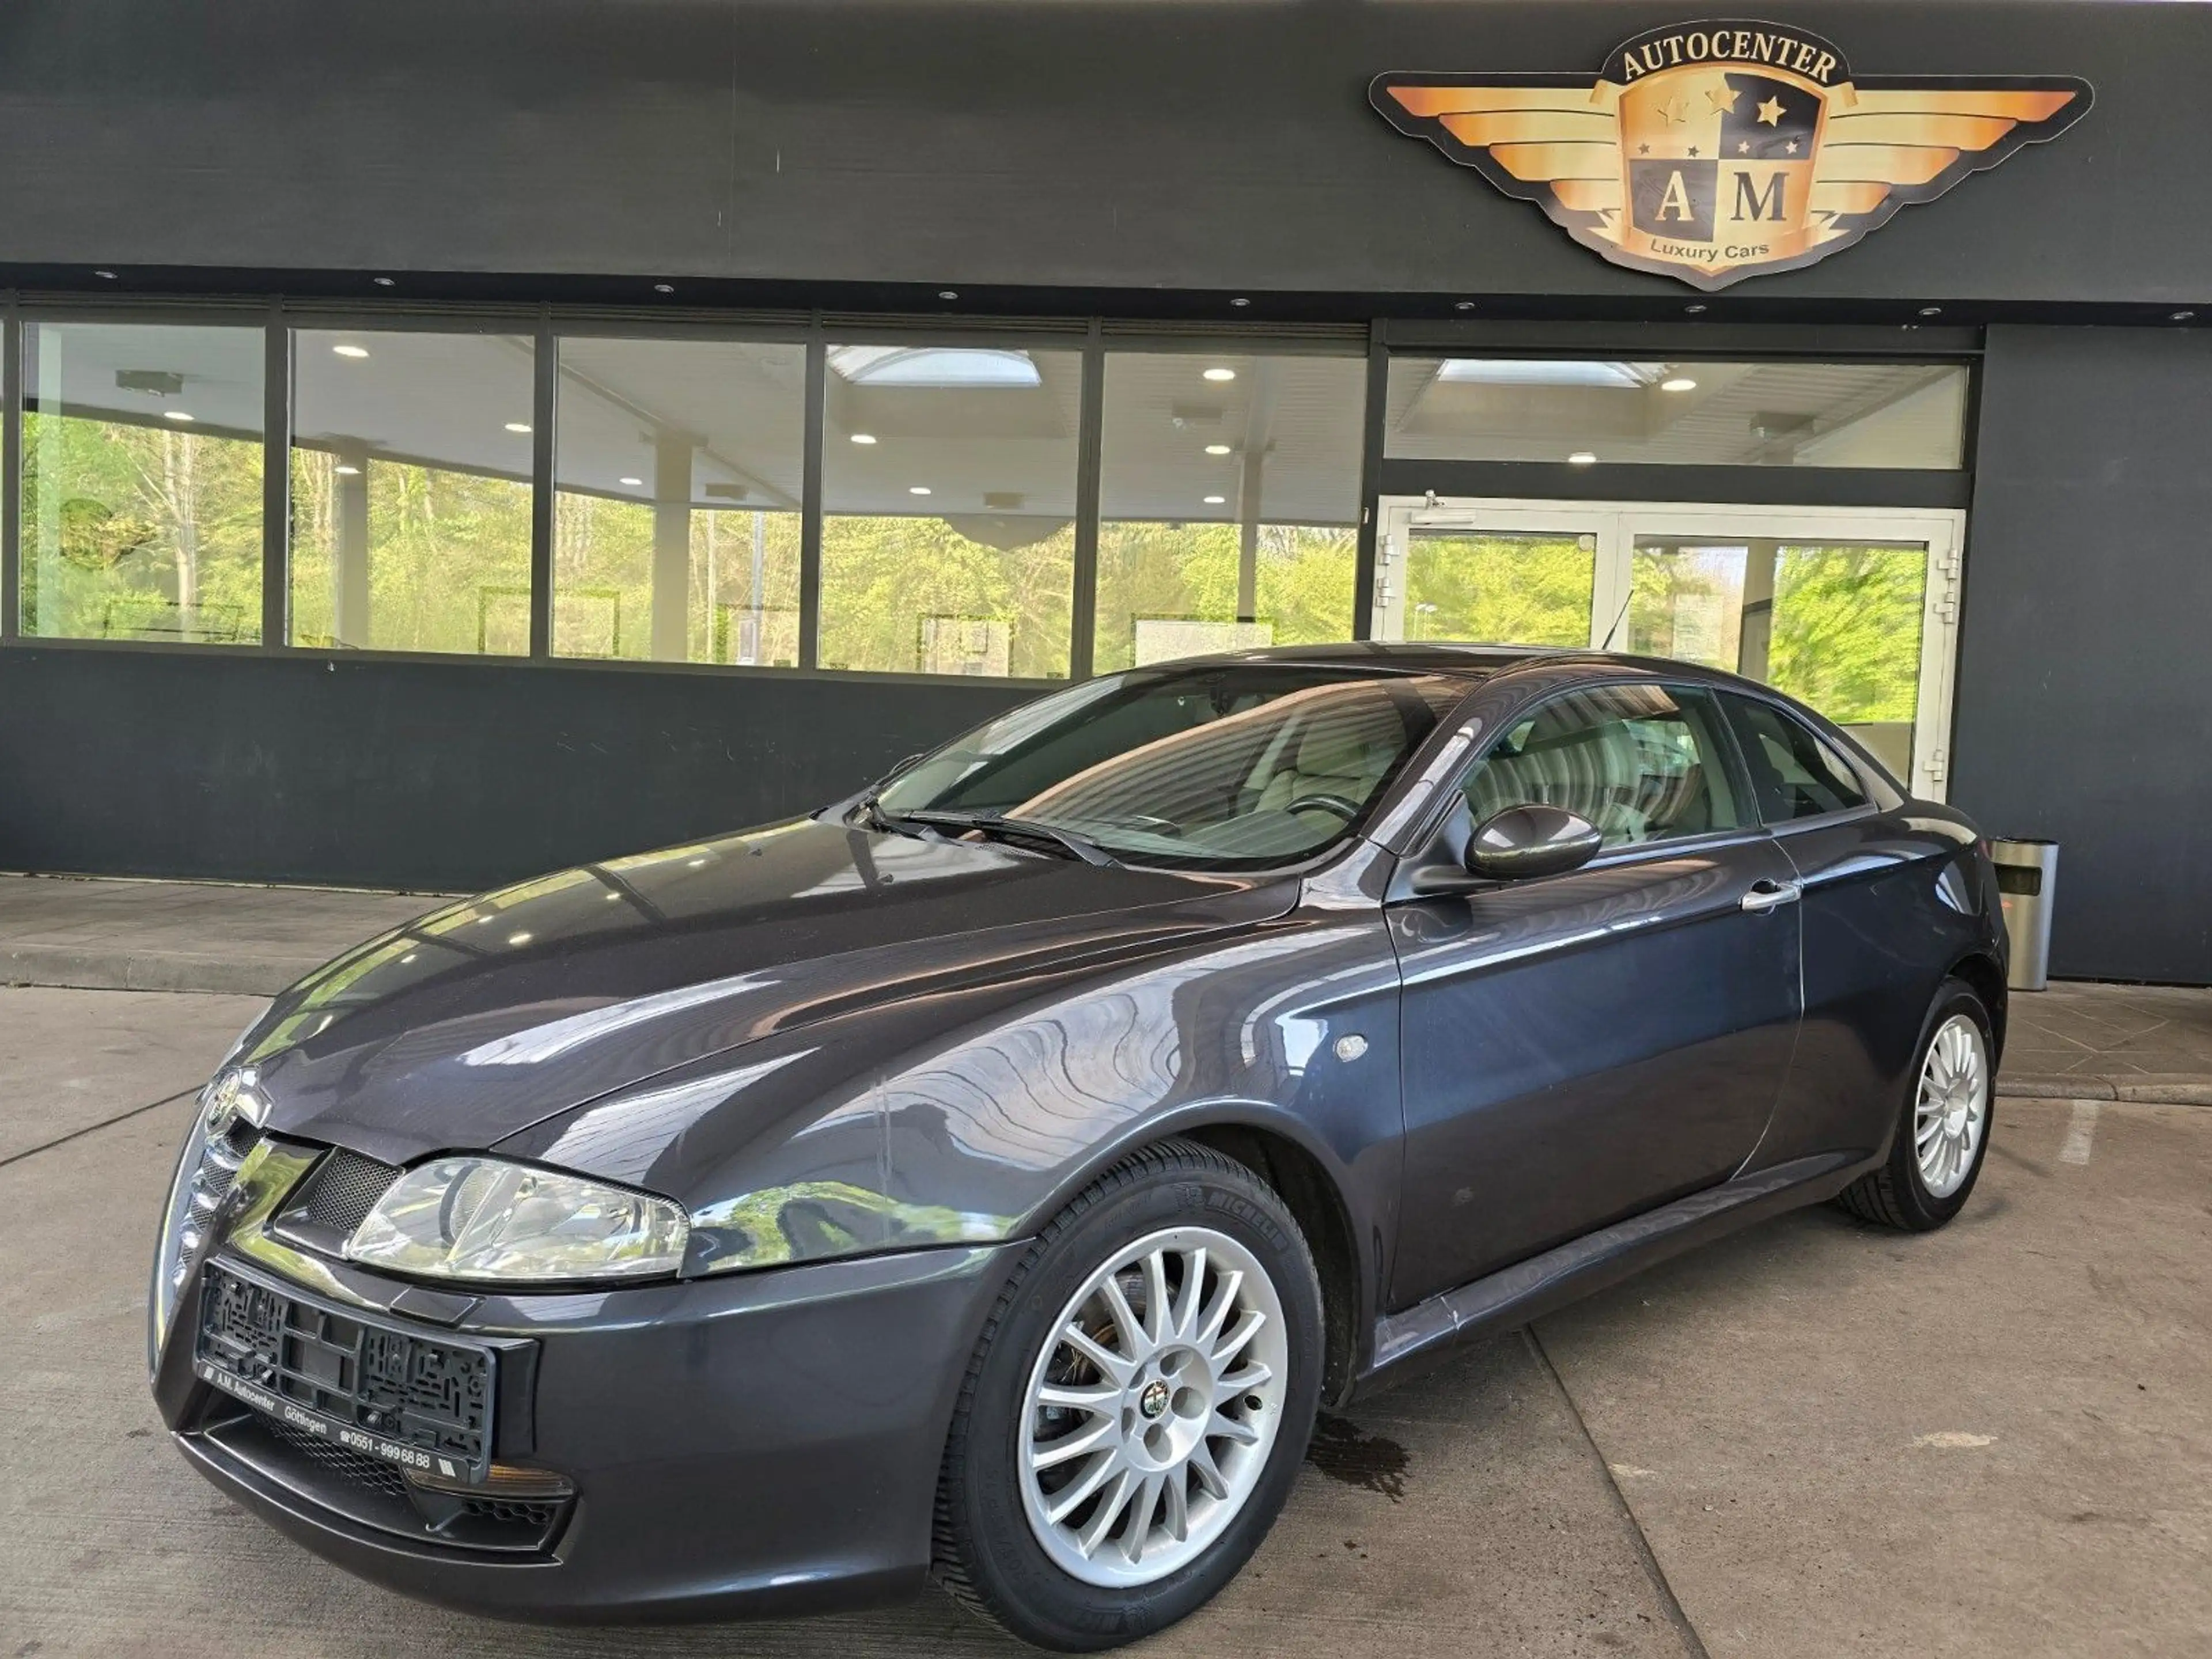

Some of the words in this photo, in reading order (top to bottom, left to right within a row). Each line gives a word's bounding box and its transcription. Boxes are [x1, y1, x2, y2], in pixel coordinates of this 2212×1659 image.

[1624, 31, 1836, 83] AUTOCENTER
[1655, 169, 1695, 221] A
[1730, 171, 1790, 221] M
[1650, 238, 1718, 262] Luxury
[1725, 243, 1770, 259] Cars
[234, 1381, 275, 1411] Autocenter
[285, 1406, 327, 1435] Göttingen
